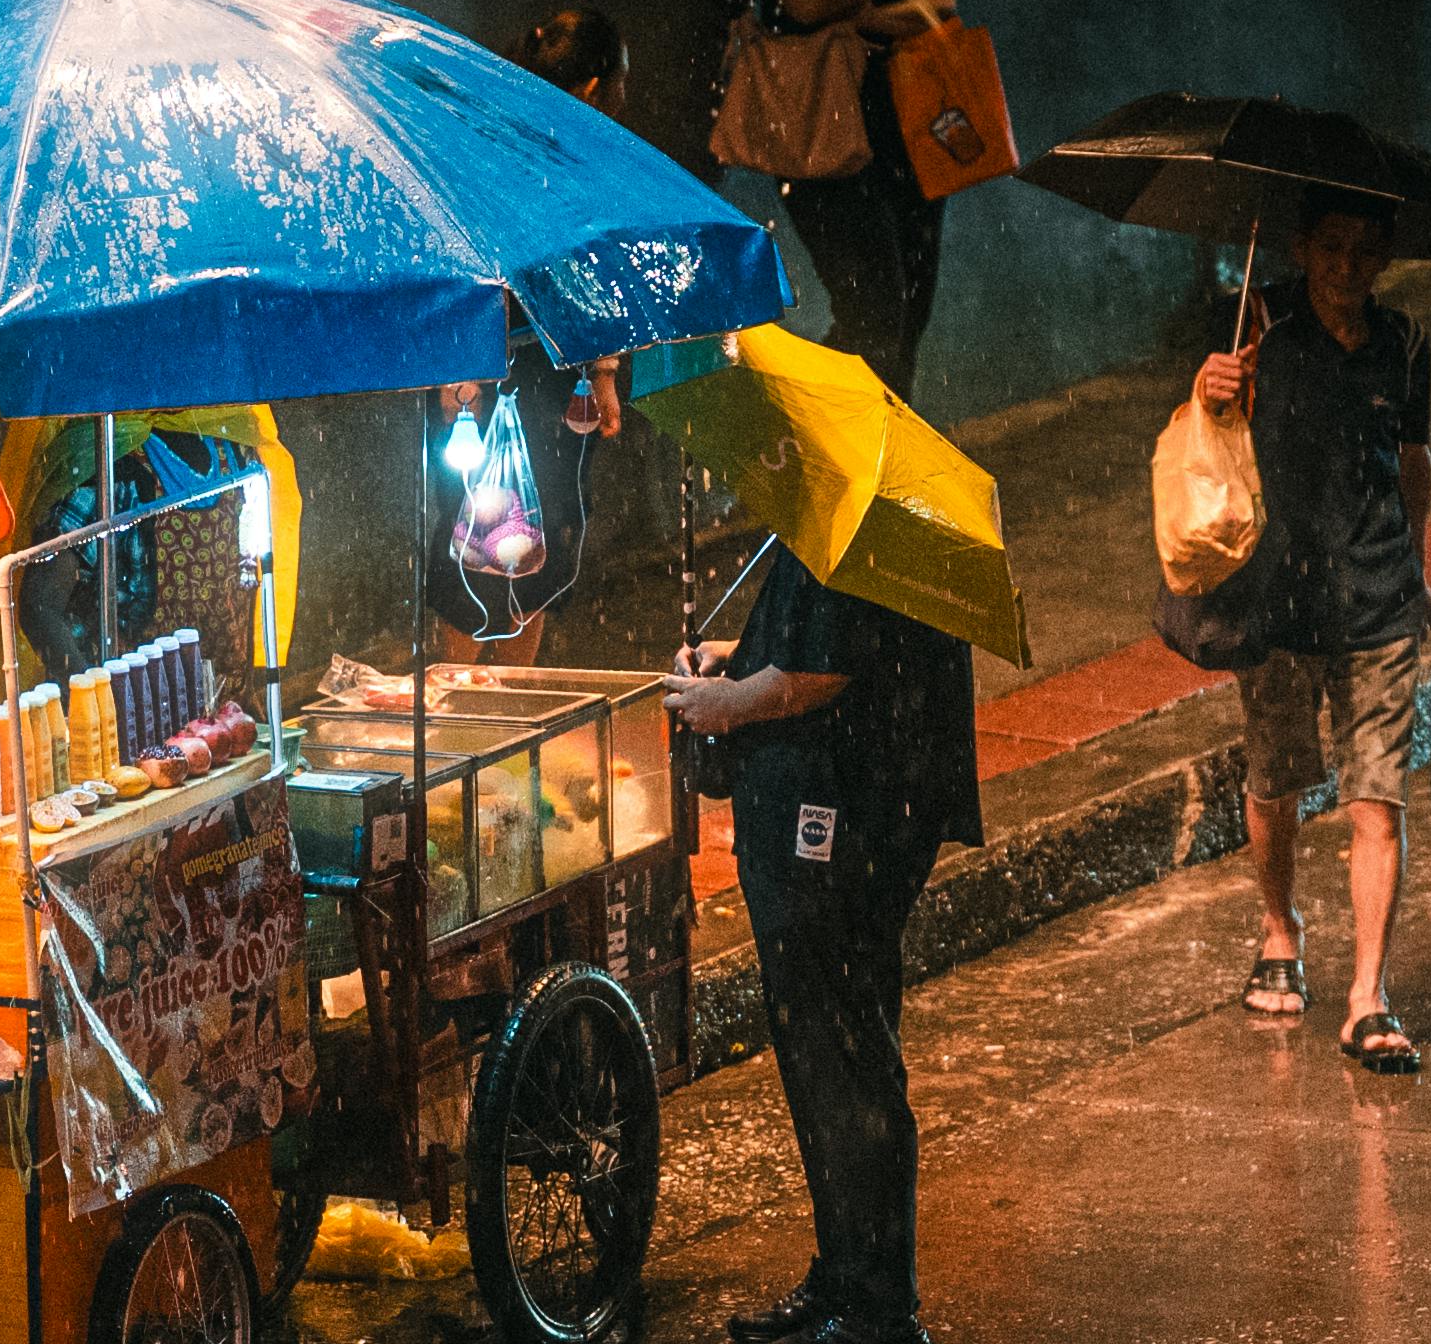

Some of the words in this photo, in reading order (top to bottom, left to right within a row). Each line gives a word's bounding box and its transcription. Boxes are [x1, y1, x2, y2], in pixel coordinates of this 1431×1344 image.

[802, 807, 833, 822] NASA
[804, 826, 827, 837] NASA
[77, 989, 134, 1050] Pre
